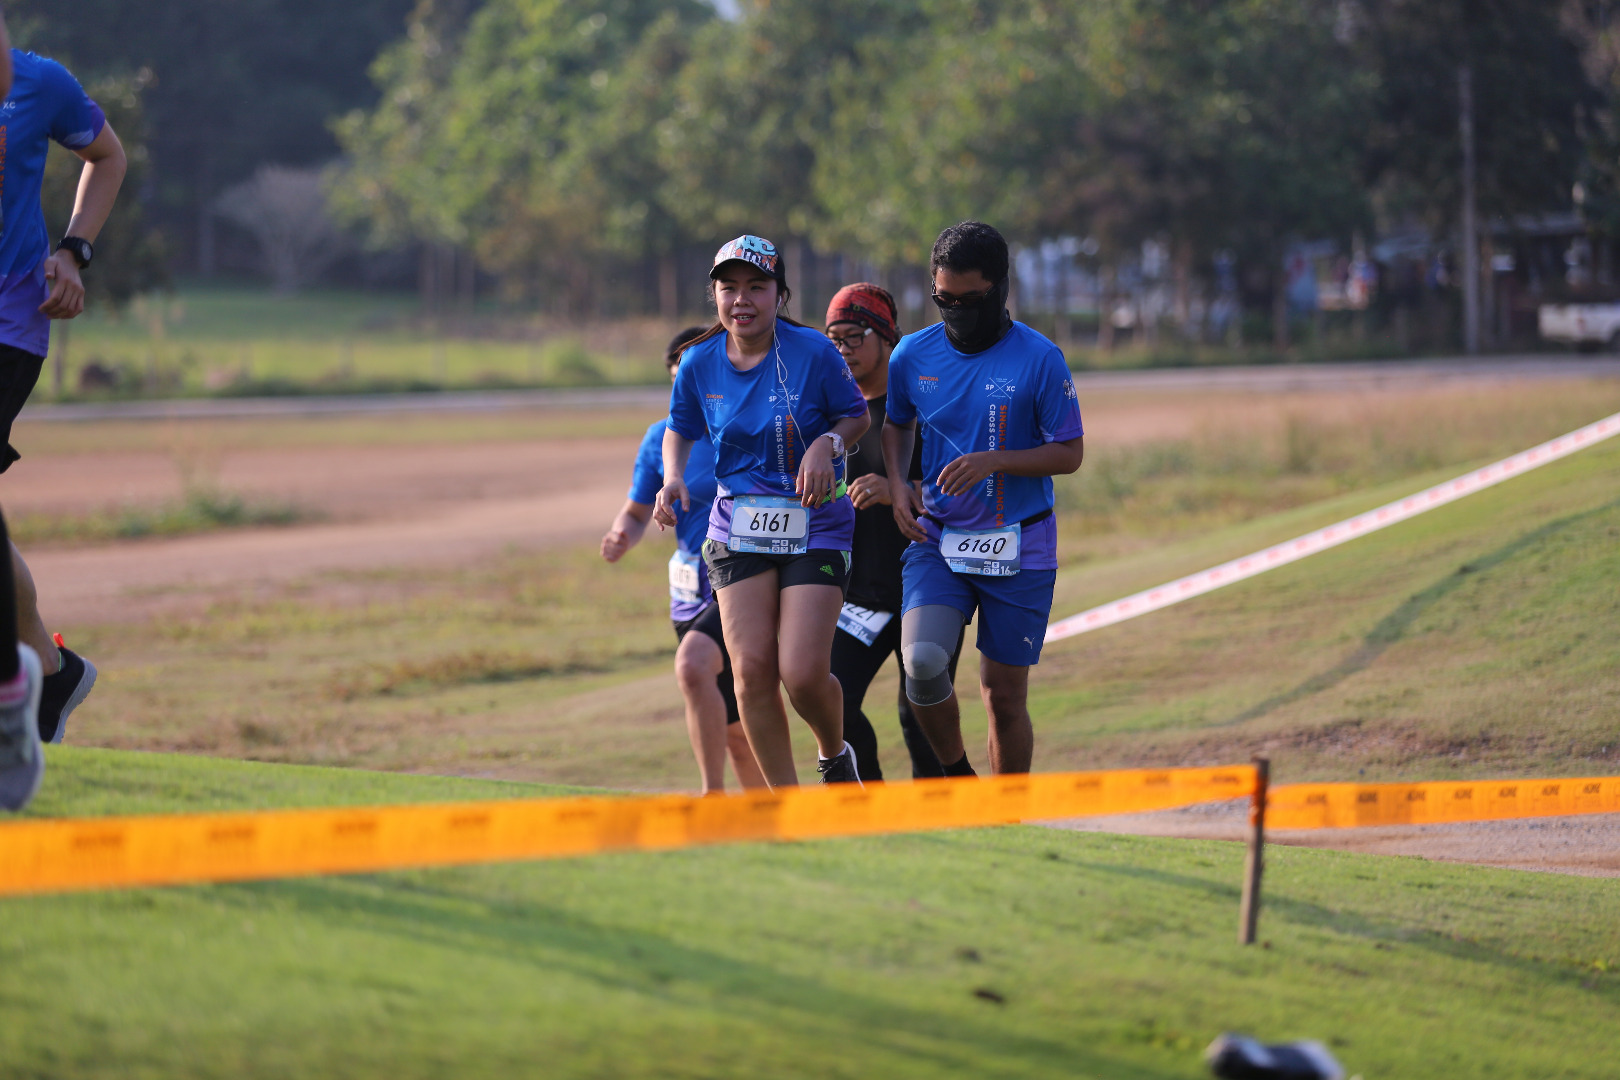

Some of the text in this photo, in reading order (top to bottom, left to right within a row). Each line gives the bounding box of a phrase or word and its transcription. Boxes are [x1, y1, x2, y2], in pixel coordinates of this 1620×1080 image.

[786, 415, 794, 448] SINGHA
[998, 405, 1008, 443] SINGHA
[775, 415, 783, 443] CROSS
[781, 475, 790, 490] RUN
[986, 479, 994, 497] RUN
[996, 473, 1005, 511] CHIANG
[750, 512, 789, 532] 6161
[995, 514, 1004, 528] RA
[790, 544, 799, 553] 16
[957, 538, 1006, 554] 6160
[1001, 565, 1010, 575] 16
